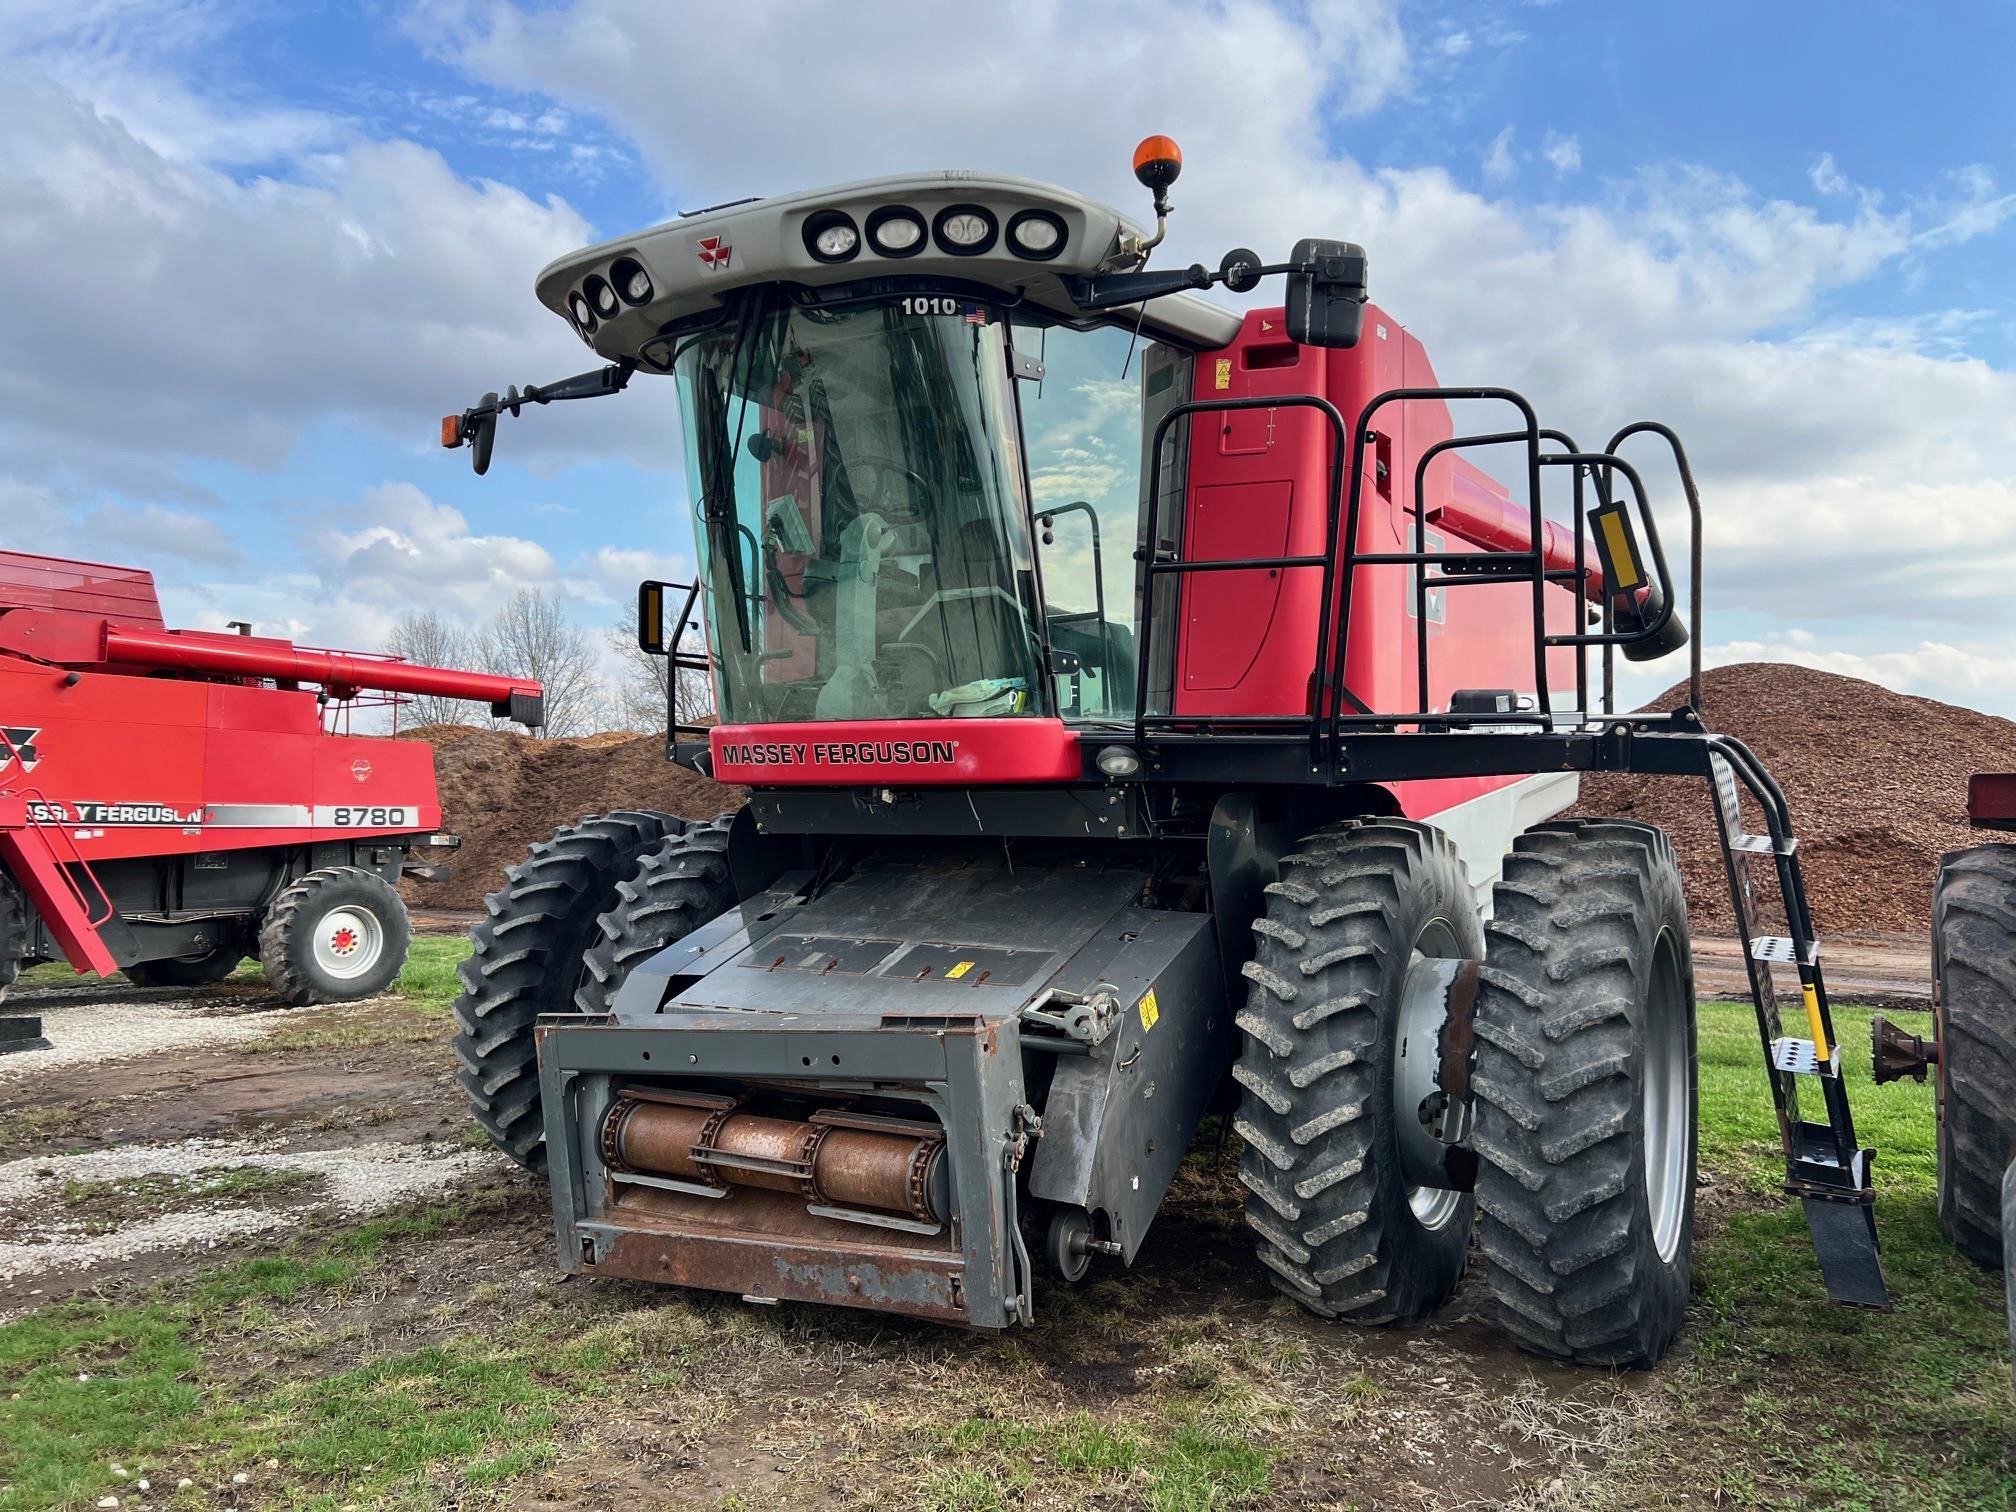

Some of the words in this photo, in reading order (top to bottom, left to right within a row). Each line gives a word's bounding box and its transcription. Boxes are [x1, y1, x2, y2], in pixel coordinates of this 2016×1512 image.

[902, 298, 956, 315] 1010
[722, 743, 807, 765] MASSEY
[334, 808, 405, 826] 8780
